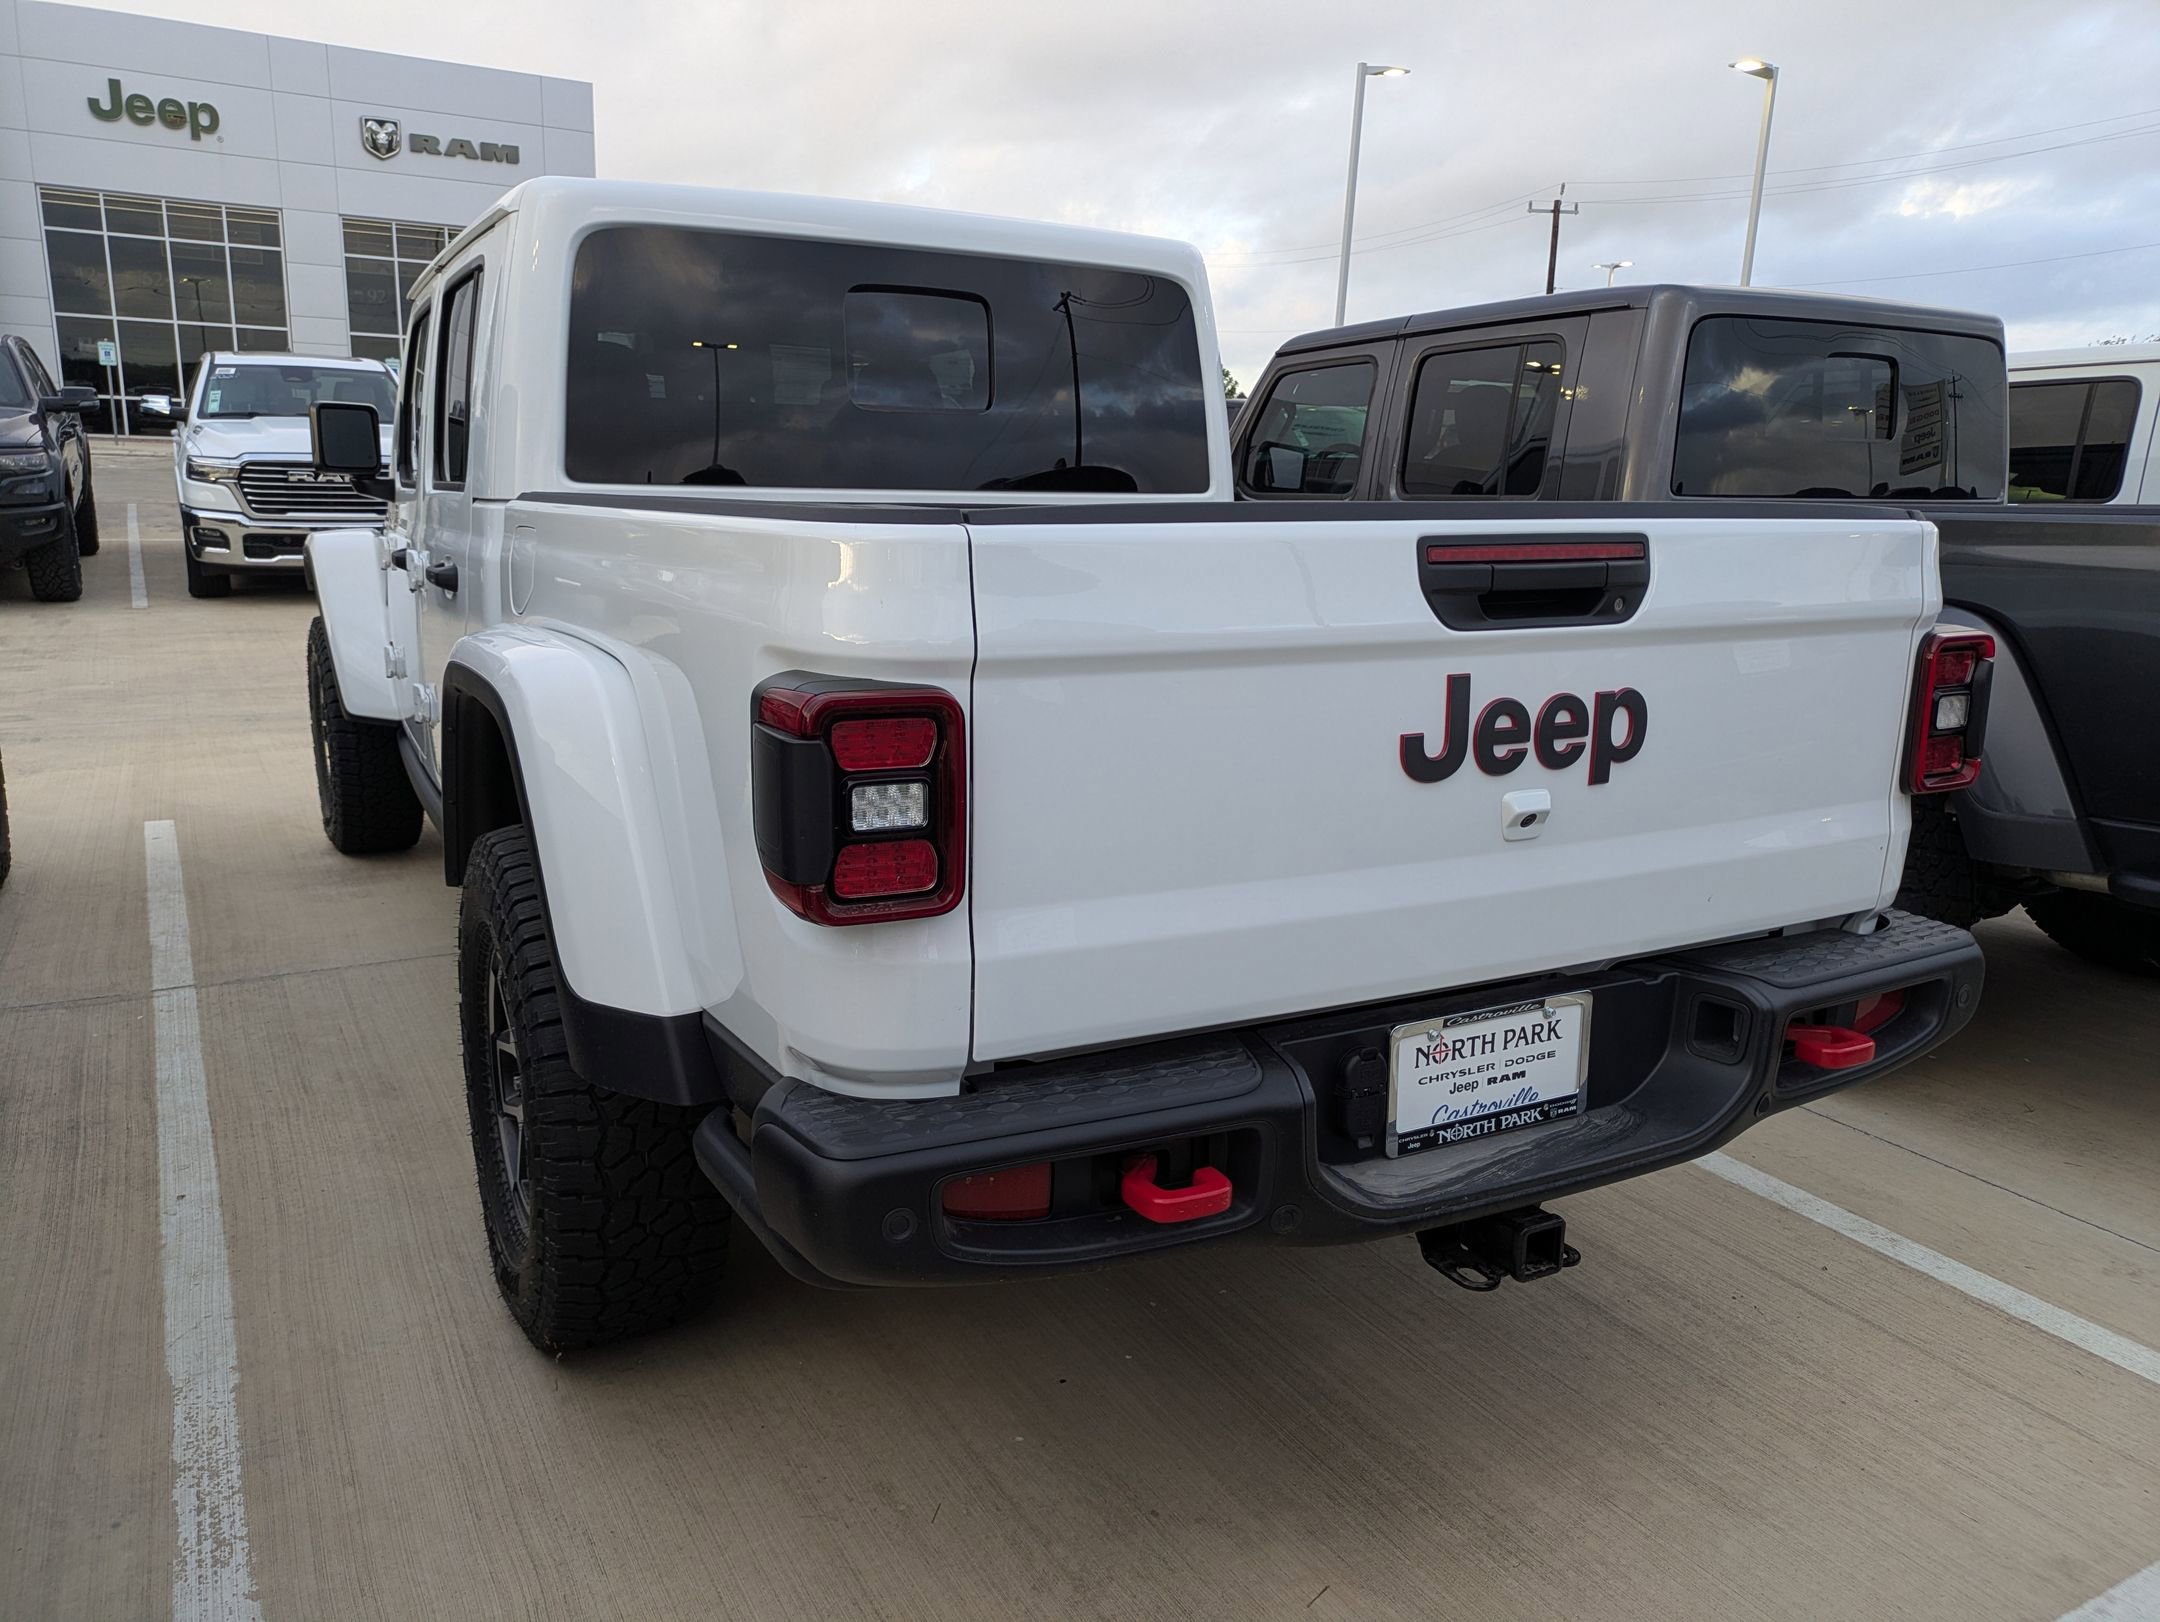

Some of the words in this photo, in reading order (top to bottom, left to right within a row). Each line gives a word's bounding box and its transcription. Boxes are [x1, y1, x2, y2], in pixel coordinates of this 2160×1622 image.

[87, 78, 220, 142] Jeep
[408, 133, 520, 164] RAM
[1399, 672, 1648, 786] Jeep
[1446, 1003, 1541, 1027] Castroville
[1414, 1032, 1497, 1069] NORTH
[1502, 1019, 1563, 1050] PARK
[1418, 1063, 1496, 1086] CHRYSLER
[1504, 1051, 1557, 1068] DODGE
[1449, 1079, 1479, 1094] Jeep
[1487, 1070, 1527, 1086] RAM
[1431, 1086, 1540, 1124] Castroville
[1558, 1105, 1577, 1114] RAM
[1436, 1118, 1497, 1145] NORTH
[1500, 1107, 1544, 1129] PARK
